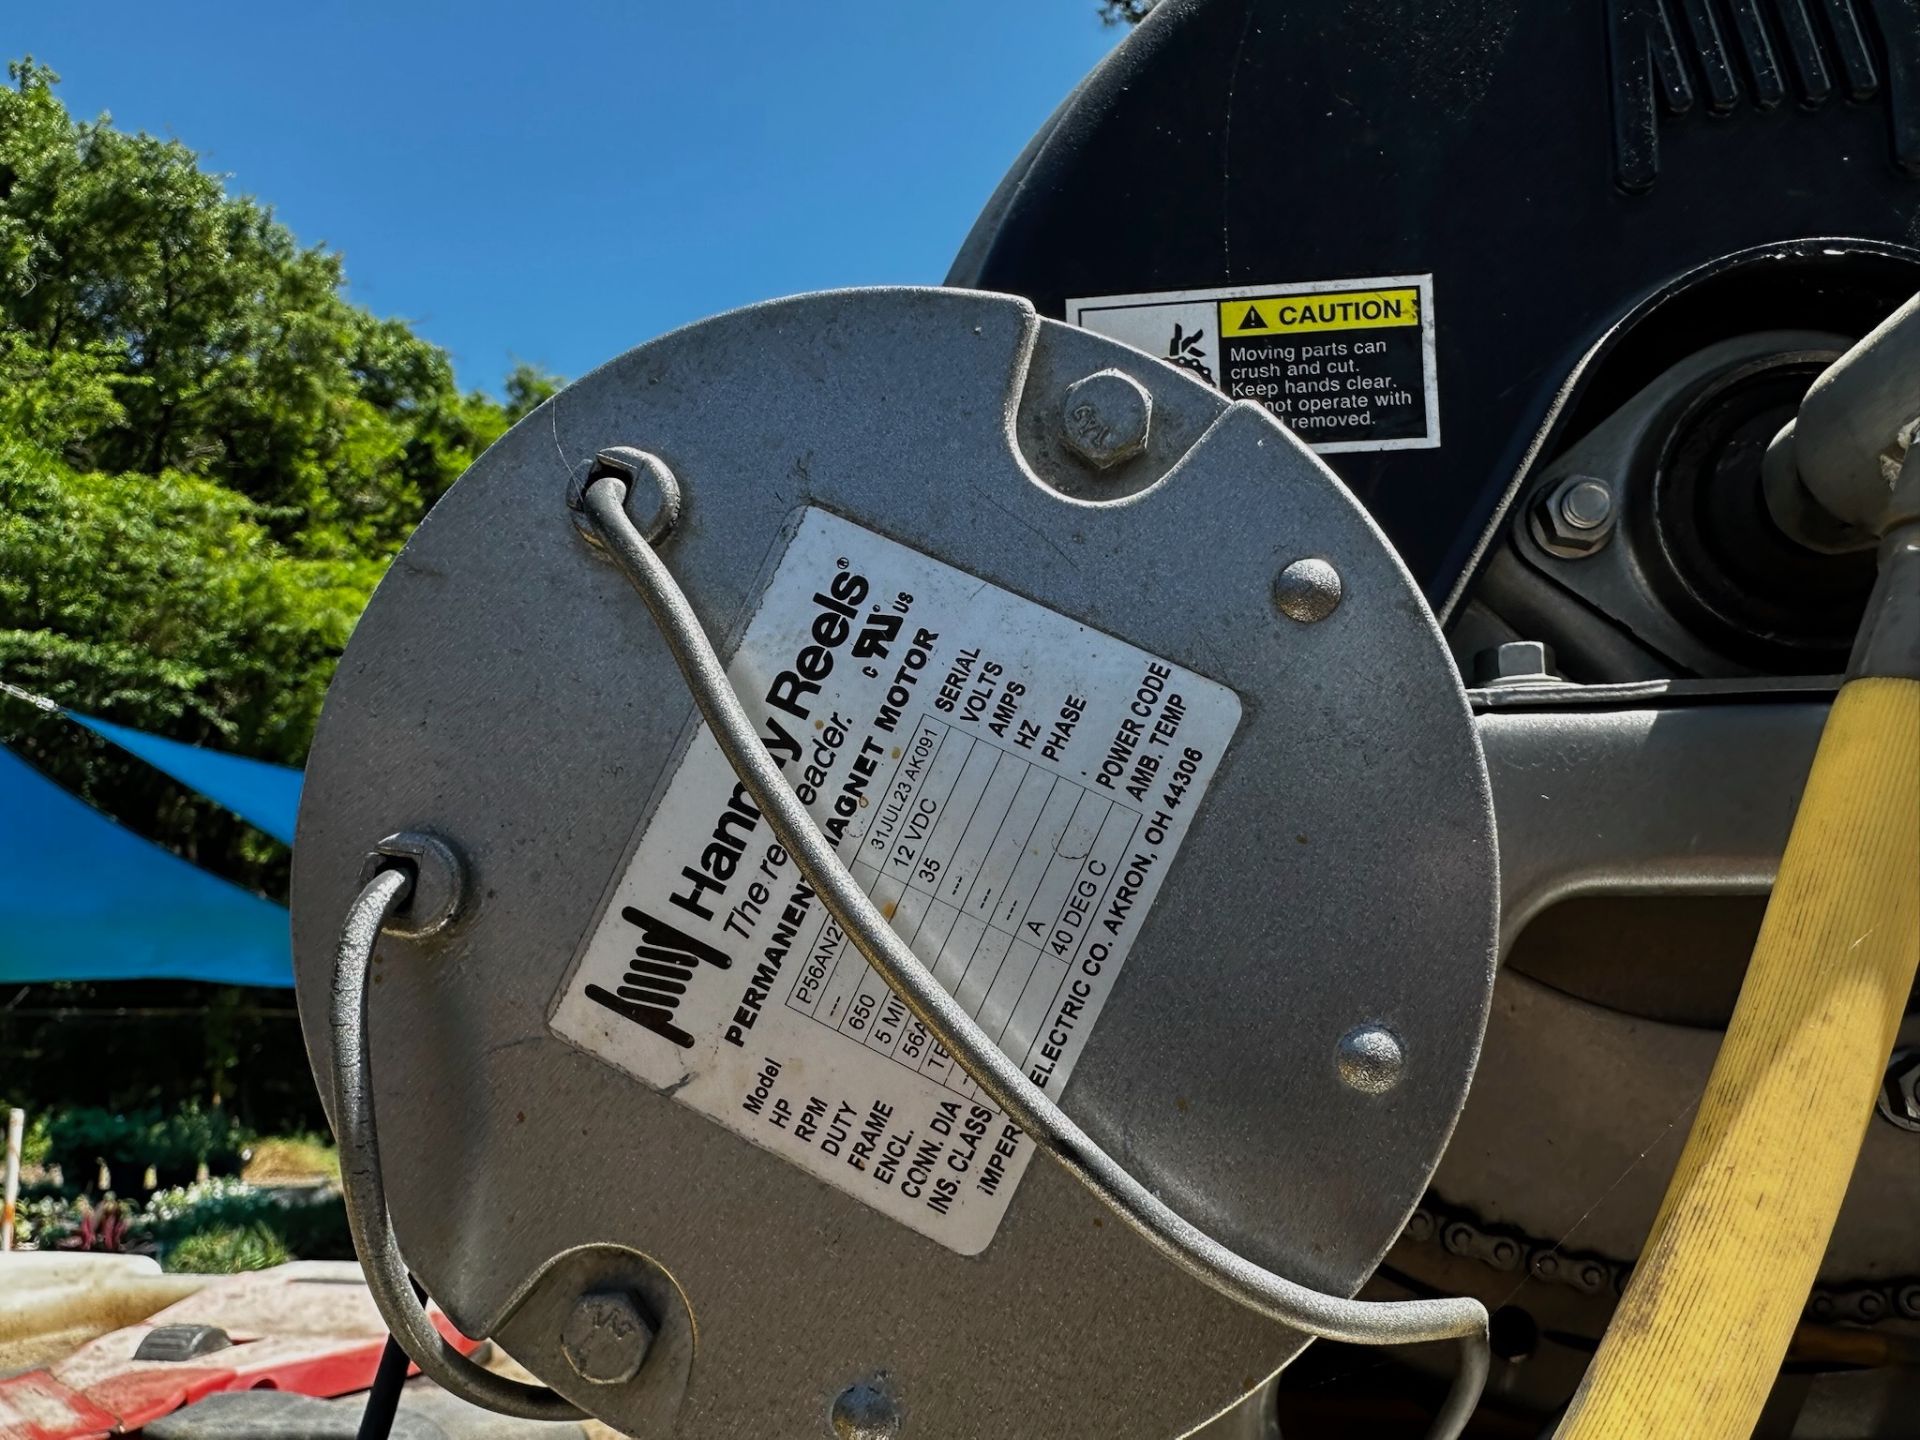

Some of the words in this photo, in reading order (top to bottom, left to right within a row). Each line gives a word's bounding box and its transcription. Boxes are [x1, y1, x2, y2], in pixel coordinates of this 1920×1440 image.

[1278, 300, 1401, 326] CAUTION
[1230, 345, 1295, 362] Moving
[1301, 344, 1347, 360] parts
[1354, 341, 1386, 354] can
[1231, 363, 1281, 380] crush
[1286, 361, 1320, 376] and
[1327, 359, 1360, 374] cut.
[1231, 382, 1279, 398] Keep
[1285, 377, 1340, 394] hands
[1346, 375, 1397, 390] clear.
[1264, 399, 1292, 413] not
[1299, 396, 1368, 414] operate
[1374, 391, 1412, 407] with
[1291, 411, 1376, 429] removed.
[934, 647, 981, 712] SERIAL
[959, 660, 1003, 722] VOLTS
[988, 680, 1026, 738] AMPS
[1013, 718, 1041, 749] HZ
[1040, 693, 1087, 762] PHASE
[1095, 718, 1145, 790] POWER
[1130, 661, 1171, 717] CODE
[1125, 754, 1163, 802] AMB.
[1148, 693, 1186, 746] TEMP
[668, 716, 803, 921] Hanny
[722, 881, 770, 939] The
[794, 710, 853, 806] eader.
[723, 873, 816, 1047] PERMANEN
[873, 627, 939, 733] MOTOR
[870, 781, 912, 850] 31JUL23
[903, 797, 937, 839] VDC
[892, 844, 915, 866] 12
[918, 856, 940, 883] 35
[1026, 921, 1046, 937] A
[1050, 929, 1073, 955] 40
[1062, 880, 1097, 928] DEG
[1087, 859, 1106, 876] C
[795, 919, 843, 1004] P56AN2
[976, 1117, 1024, 1196] IMPER
[1081, 941, 1113, 976] CO.
[1102, 852, 1158, 936] AKRON,
[1144, 810, 1173, 845] OH
[1162, 746, 1203, 809] 44306
[848, 993, 875, 1030] 650
[874, 1028, 892, 1044] 5
[742, 1056, 782, 1115] Model
[768, 1097, 792, 1129] HP
[793, 1095, 828, 1142] RPM
[820, 1099, 857, 1156] DUTY
[846, 1099, 894, 1171] FRAME
[872, 1129, 914, 1184] ENCL.
[900, 1138, 944, 1198] CONN.
[929, 1101, 962, 1136] DIA
[926, 1177, 961, 1215] INS.
[947, 1105, 993, 1172] CLASS
